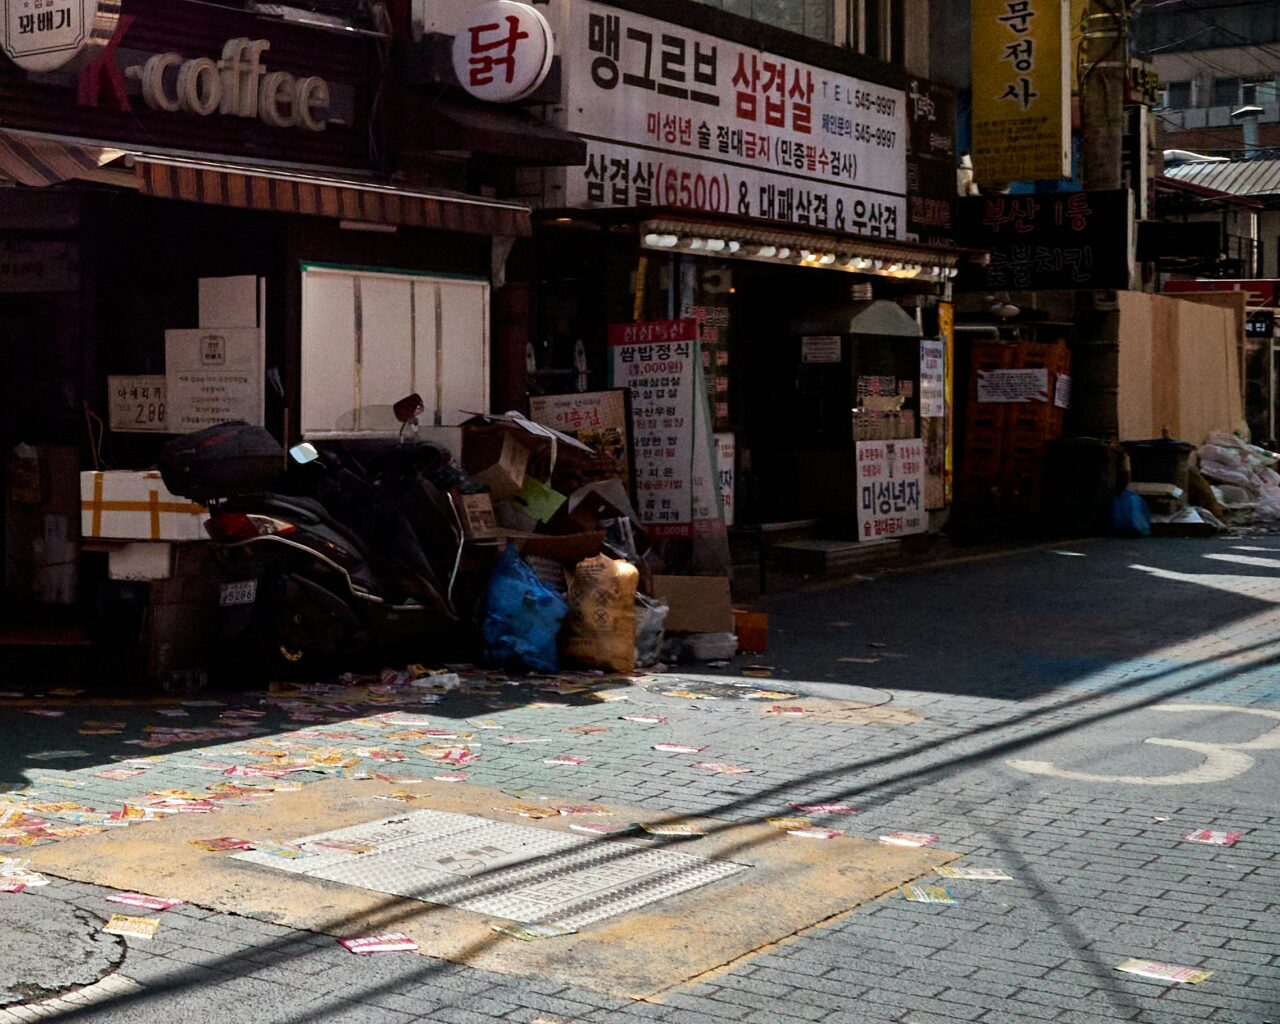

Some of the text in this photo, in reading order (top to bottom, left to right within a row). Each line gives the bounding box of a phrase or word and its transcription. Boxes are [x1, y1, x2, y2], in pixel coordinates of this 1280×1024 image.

[19, 8, 71, 34] 꽈배기
[468, 16, 529, 86] 닭
[142, 37, 330, 131] coffee
[588, 14, 721, 106] 맹그르브
[731, 52, 815, 135] 삼겹살
[854, 88, 897, 117] 545-9997
[647, 111, 858, 180] 미성년 술 절대금지 (민증필수검사)
[854, 122, 897, 149] 545-9997
[738, 181, 749, 205] &
[983, 197, 1040, 233] 부산
[620, 342, 689, 363] 쌈밥정식
[862, 479, 920, 515] 미성년자
[864, 520, 873, 537] 술
[874, 517, 904, 536] 절대금지
